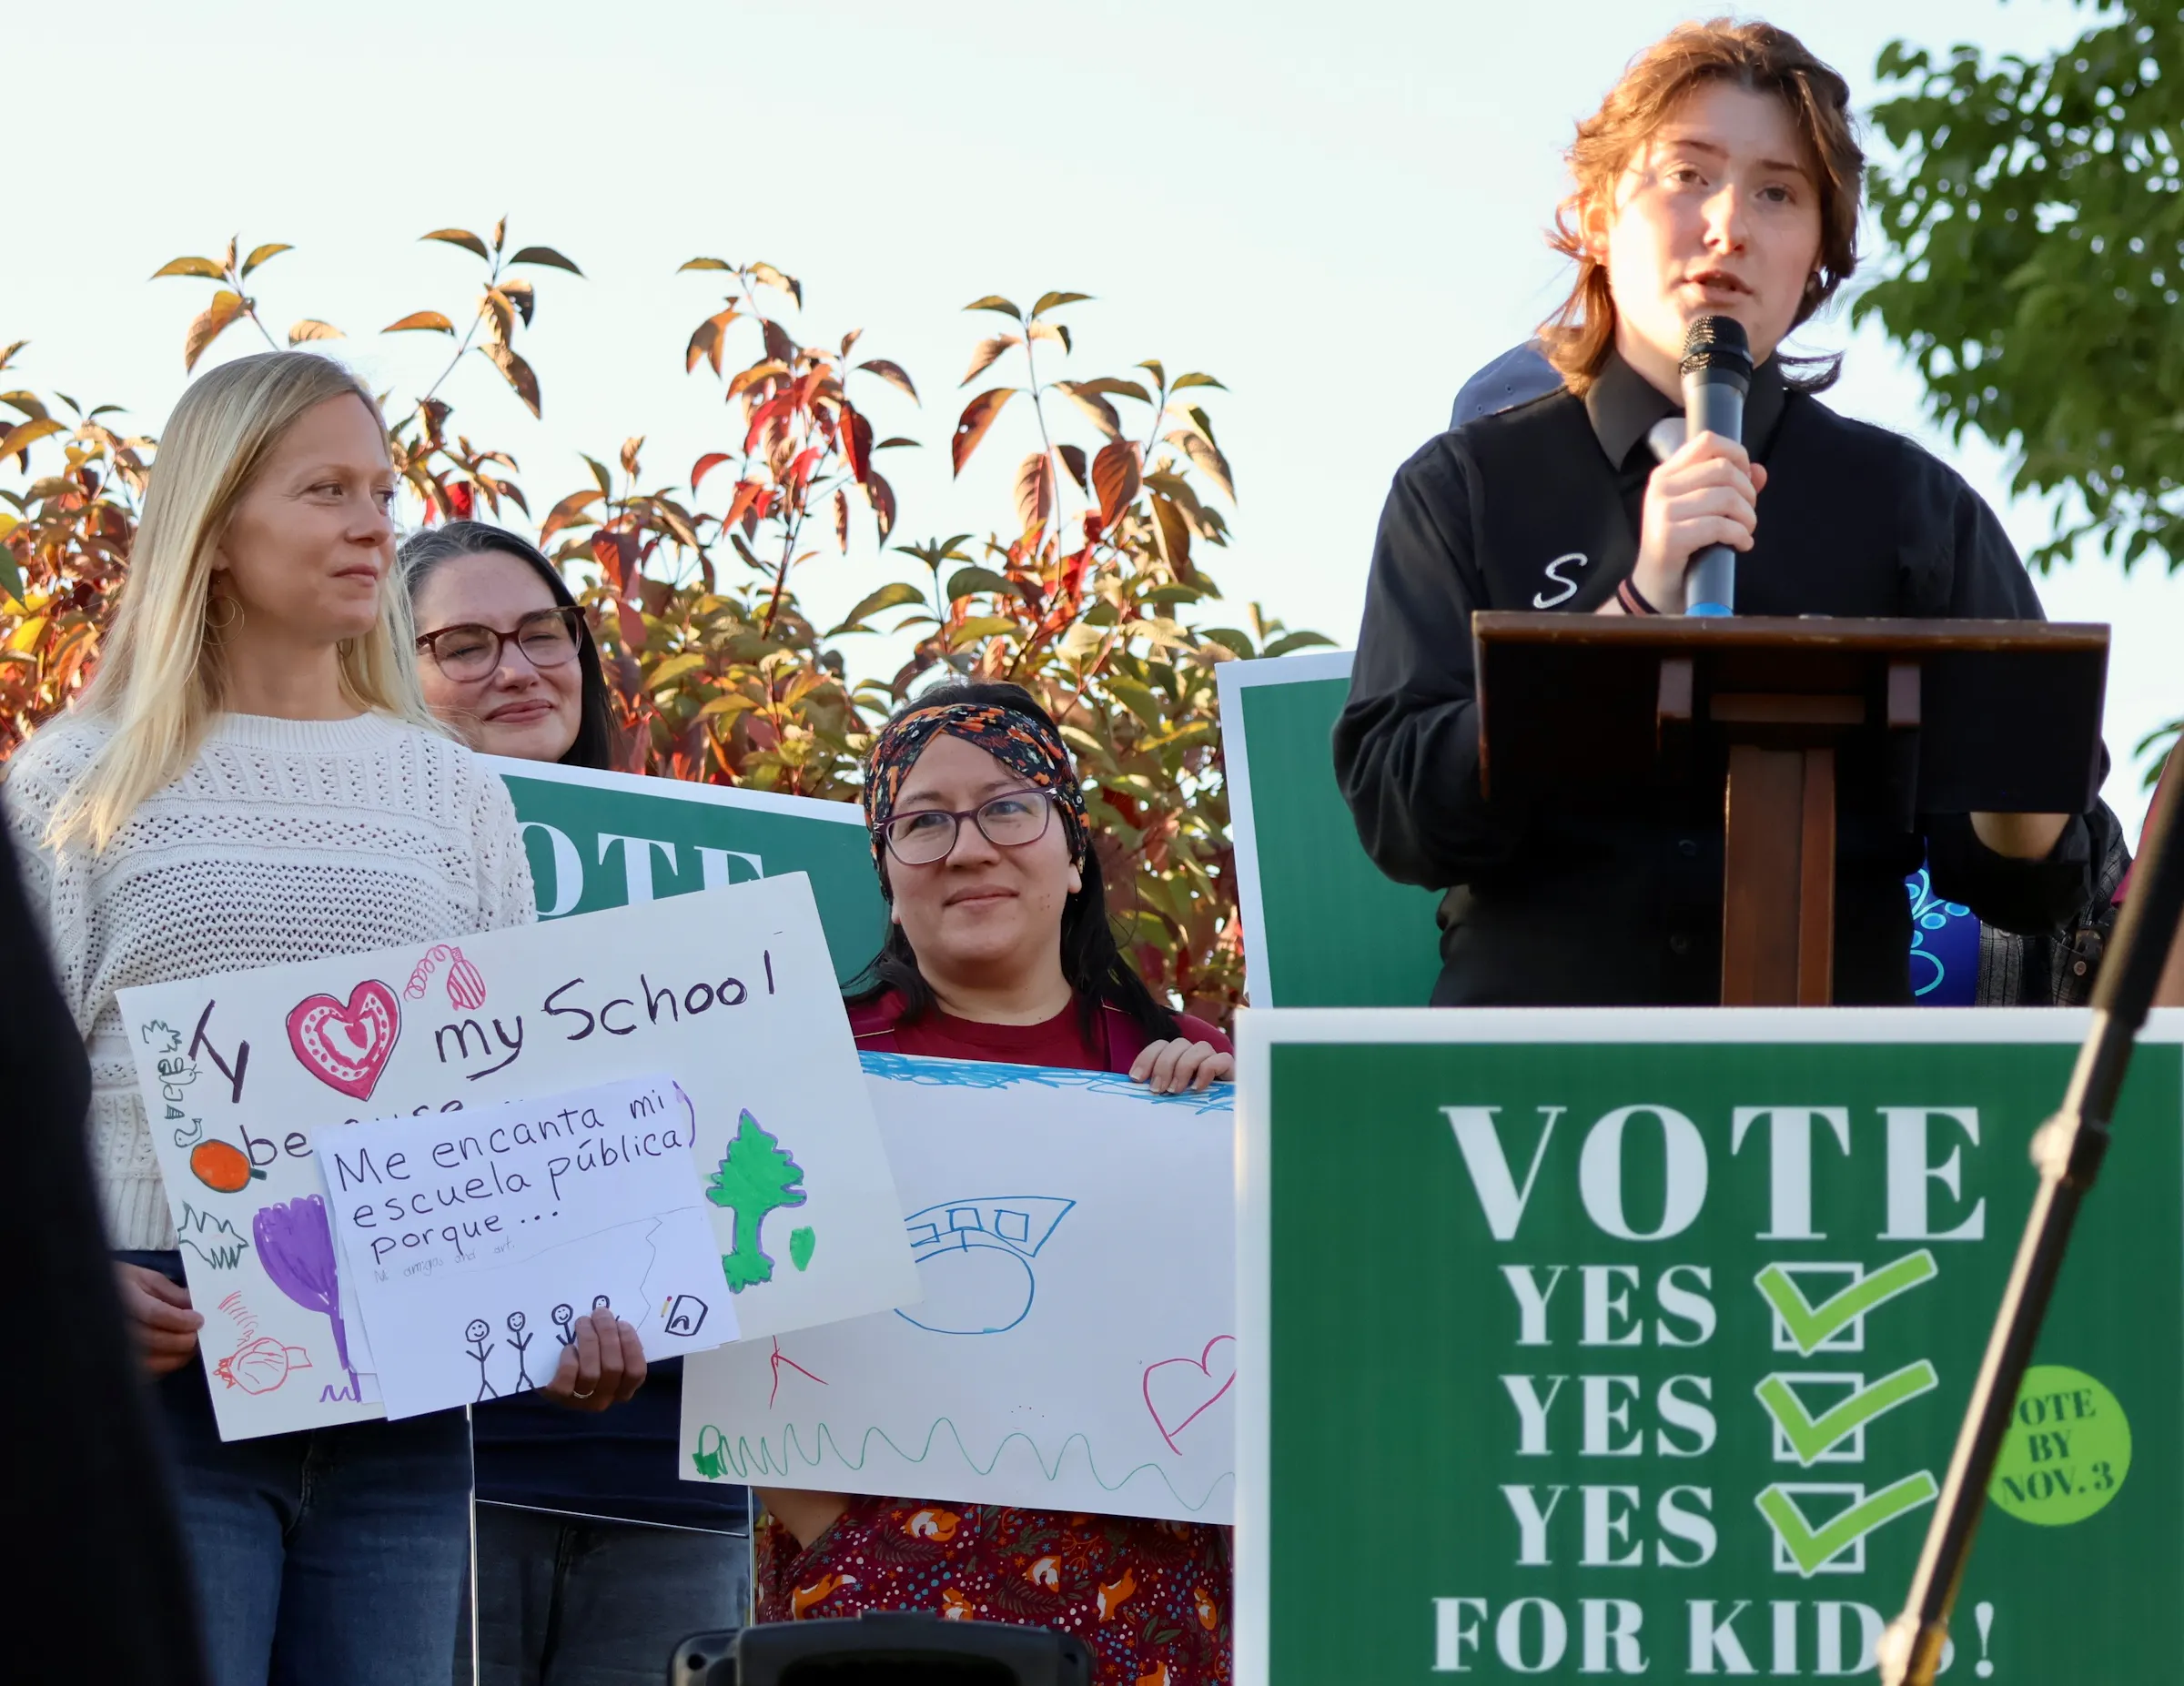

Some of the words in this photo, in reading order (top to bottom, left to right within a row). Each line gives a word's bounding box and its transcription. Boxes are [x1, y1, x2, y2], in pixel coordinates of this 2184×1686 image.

[1532, 552, 1588, 610] S
[434, 1015, 524, 1081] my
[542, 950, 776, 1042] School
[334, 1148, 410, 1191] Me
[432, 1107, 604, 1168] encanta
[630, 1089, 665, 1120] mi
[353, 1161, 531, 1228] escuela
[547, 1129, 682, 1201] pública
[1439, 1104, 1987, 1241] VOTE
[1499, 1265, 1718, 1348] YES
[1499, 1375, 1718, 1458] YES
[2017, 1388, 2097, 1426] OTE
[2027, 1429, 2071, 1463] BY
[2002, 1467, 2087, 1506] NOV.
[2091, 1460, 2115, 1490] 3
[1499, 1485, 1718, 1568] YES
[1431, 1597, 1651, 1674] FOR
[1684, 1600, 1996, 1679] KID!
